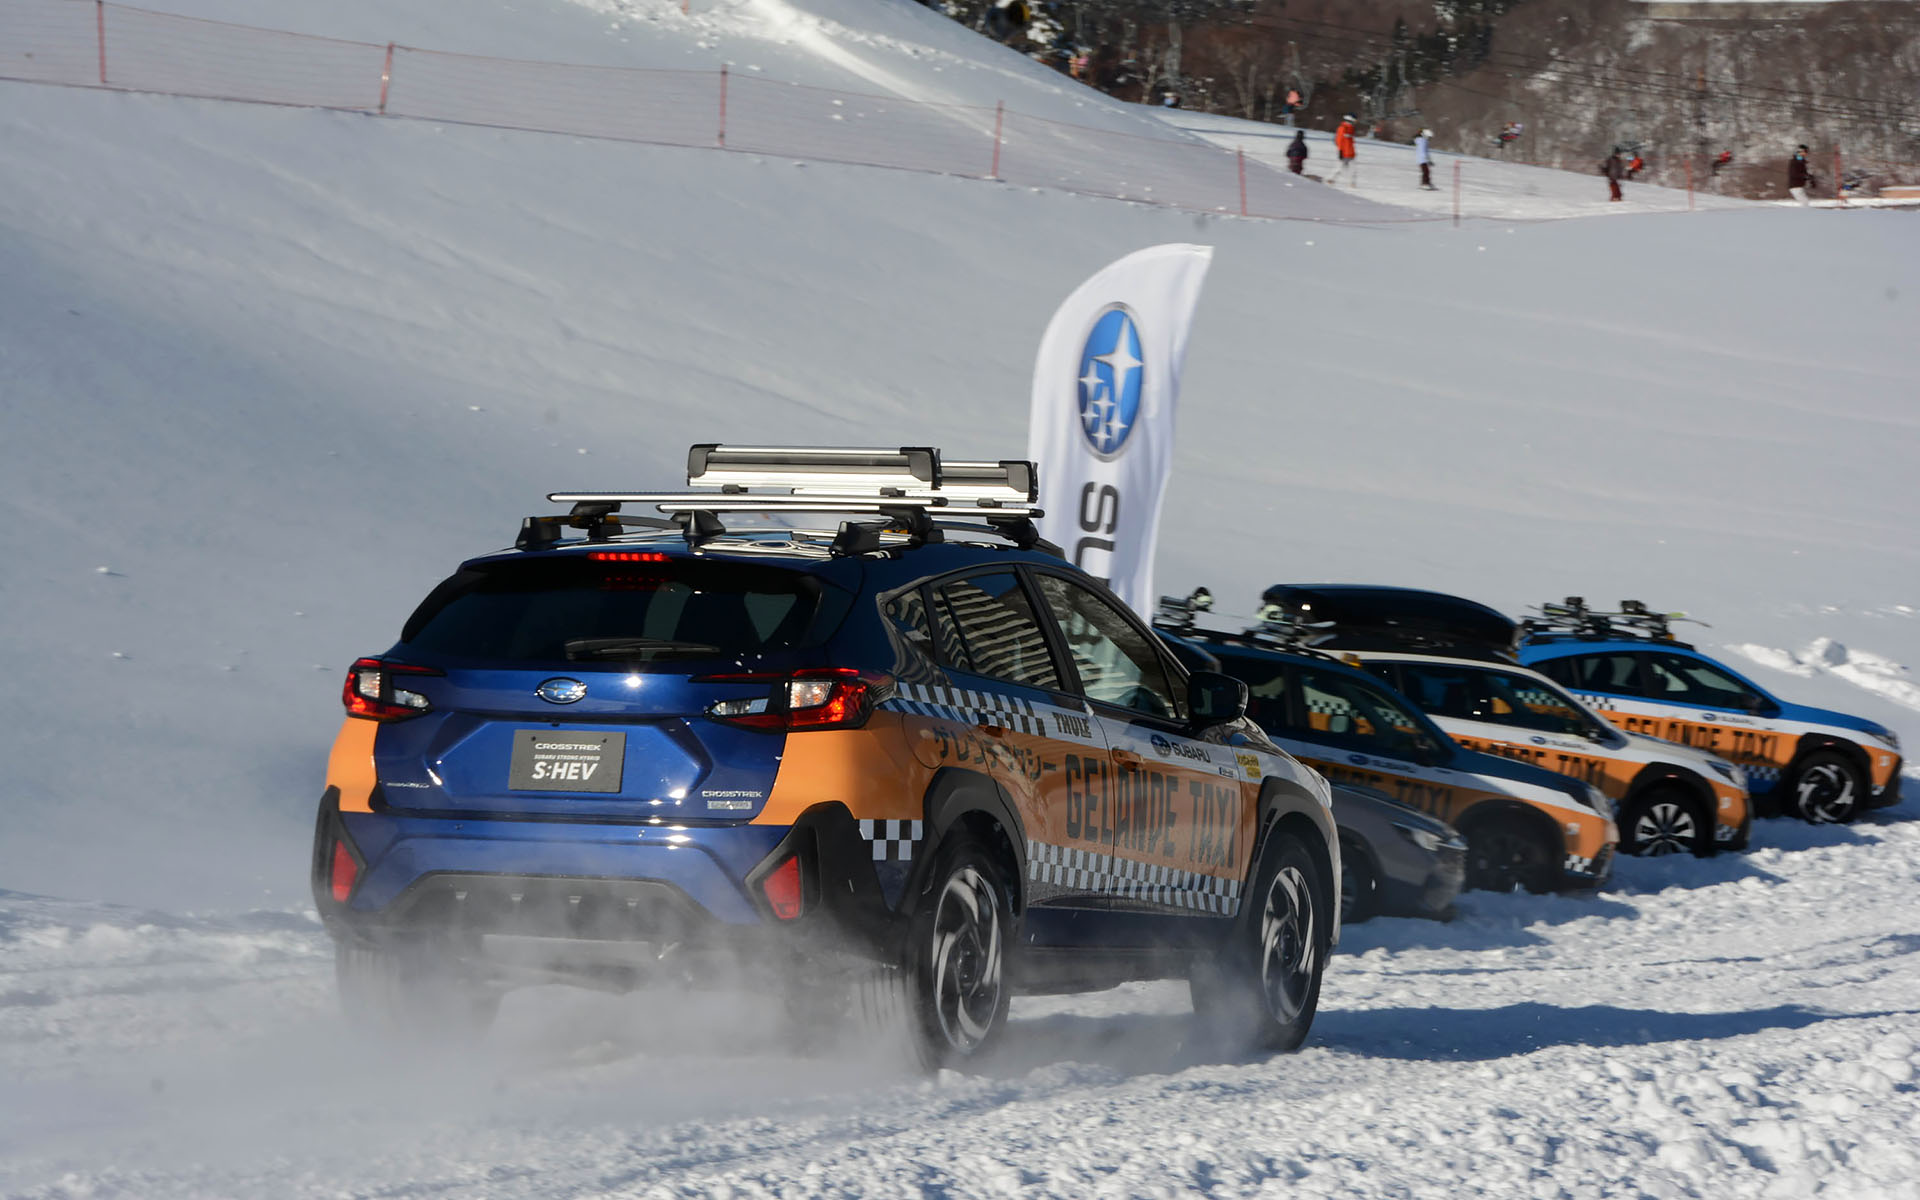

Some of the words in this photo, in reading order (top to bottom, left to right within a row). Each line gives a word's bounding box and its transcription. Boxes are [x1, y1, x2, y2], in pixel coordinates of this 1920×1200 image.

[1052, 712, 1092, 738] THULE
[535, 743, 601, 751] CROSSTREK
[1171, 741, 1212, 763] SUBARU
[1733, 730, 1778, 762] TAXI
[531, 761, 598, 780] S:HEV
[702, 790, 763, 798] CROSSTREK
[1189, 779, 1236, 869] TAXI
